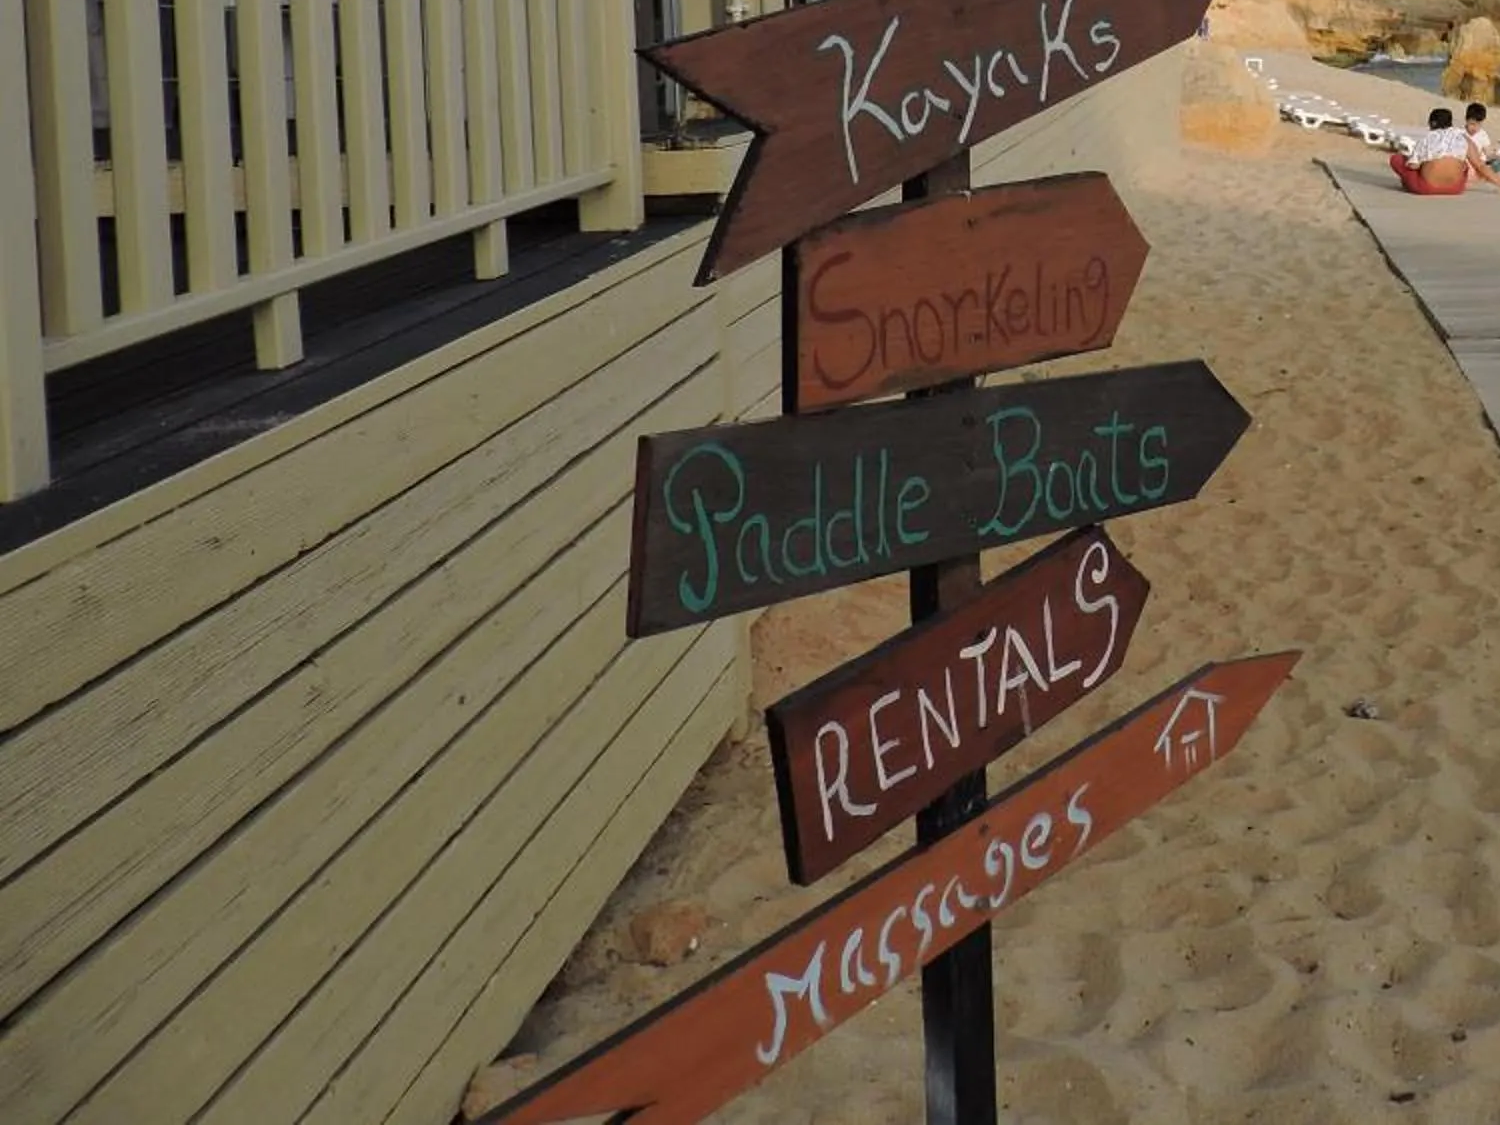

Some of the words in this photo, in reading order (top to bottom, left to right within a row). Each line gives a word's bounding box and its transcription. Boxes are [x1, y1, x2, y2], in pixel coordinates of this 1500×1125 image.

[663, 440, 932, 613] Paddle
[977, 406, 1170, 537] Boats
[813, 542, 1119, 842] RENTALS
[756, 781, 1093, 1066] Massages
